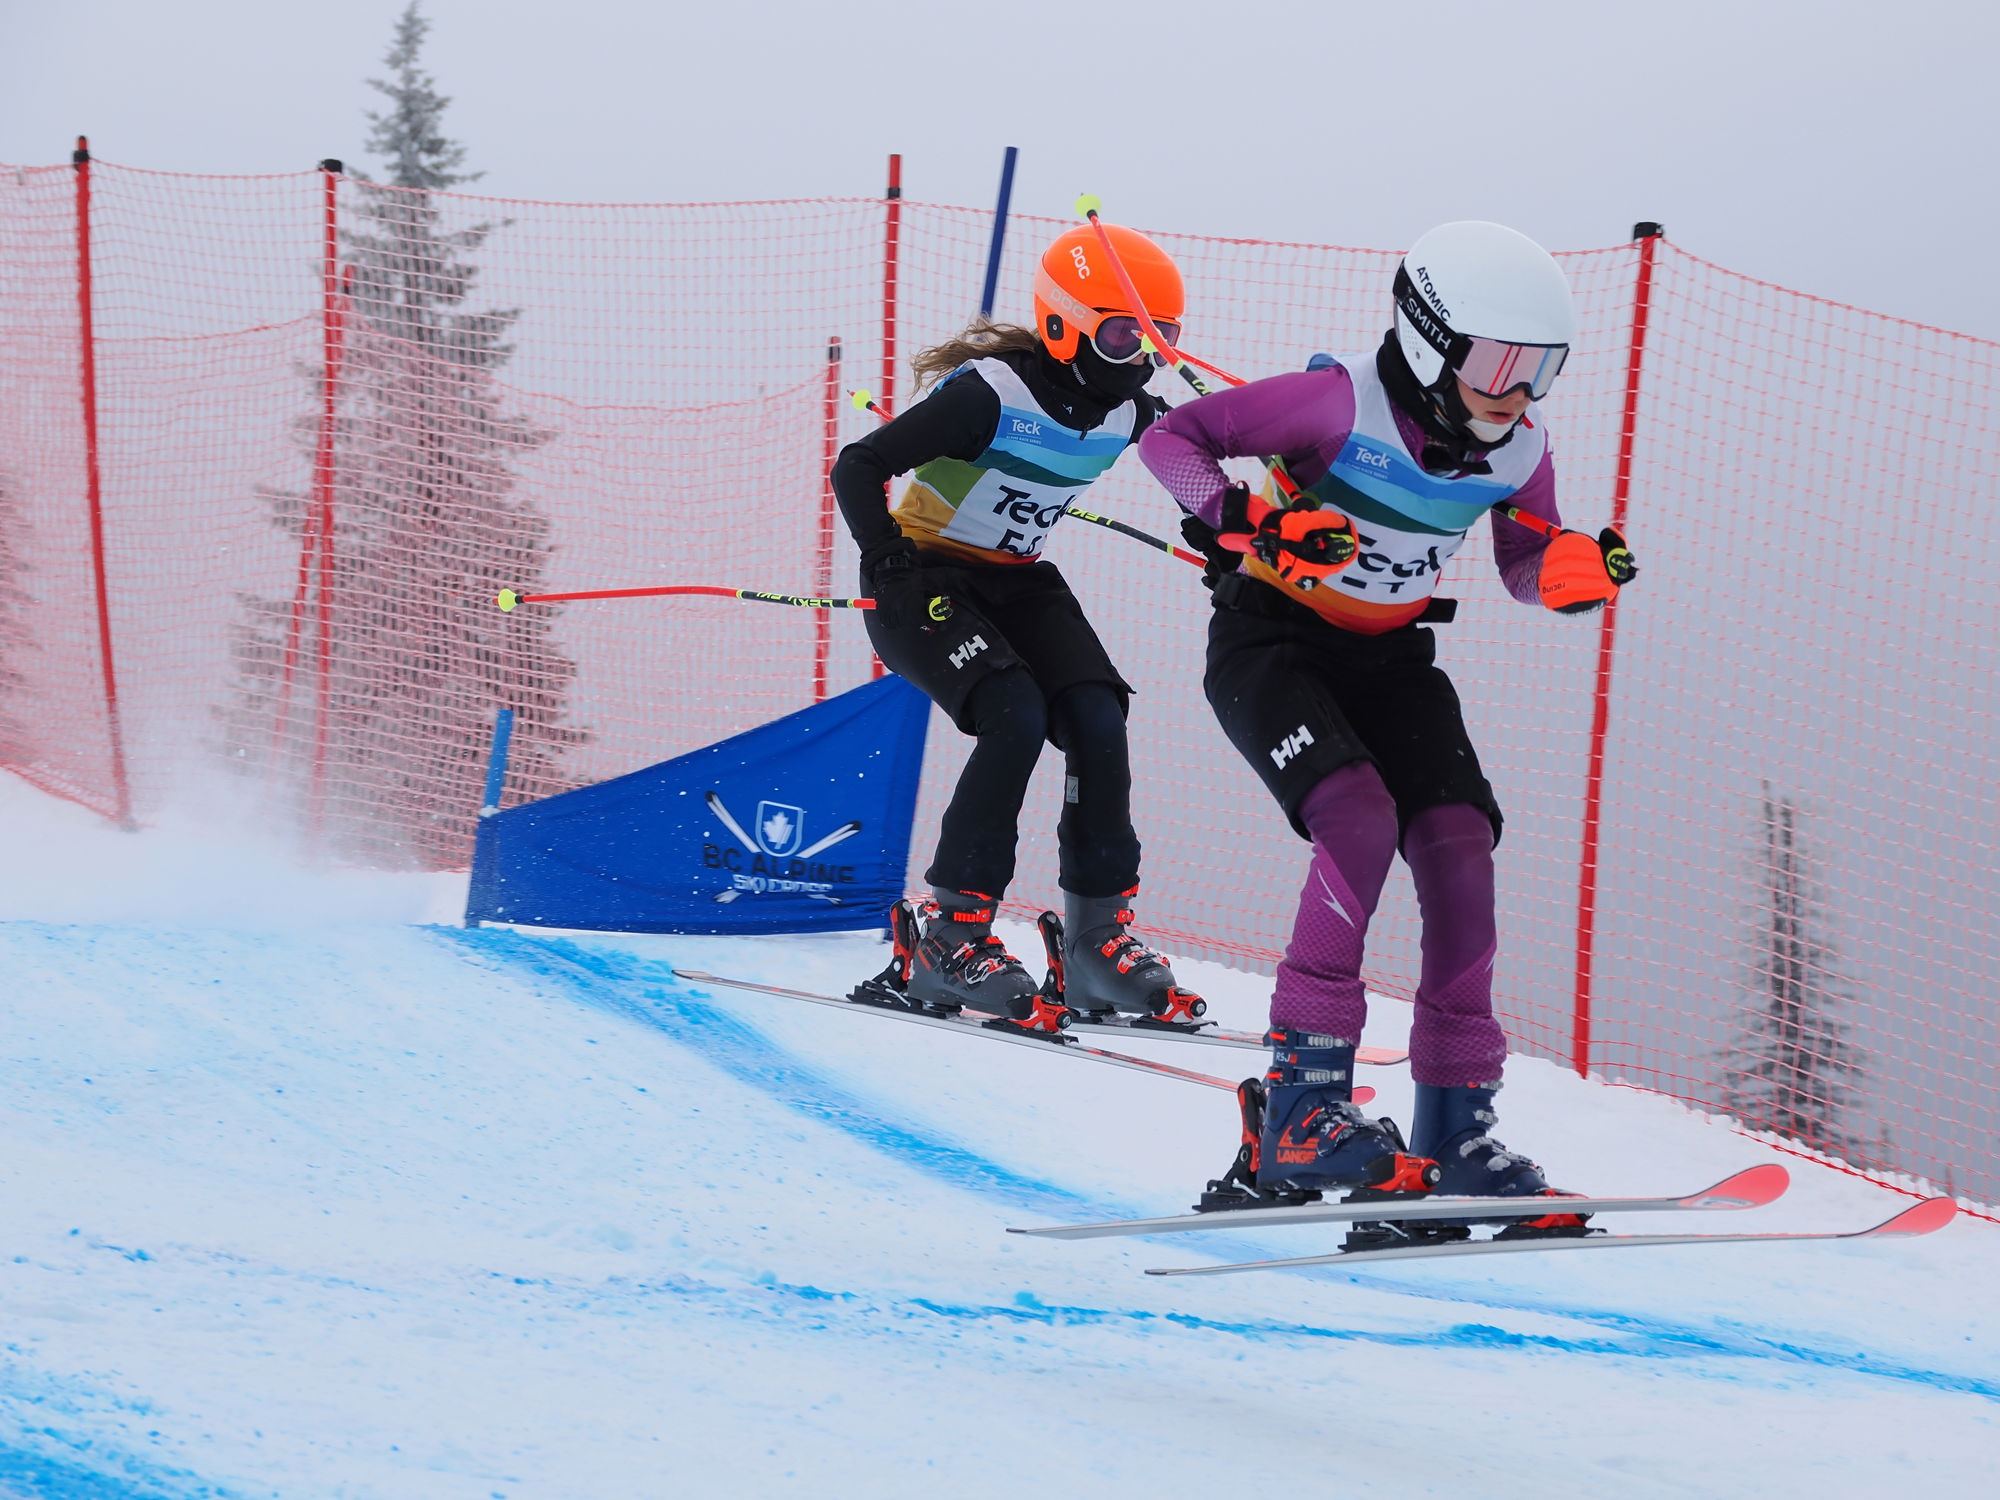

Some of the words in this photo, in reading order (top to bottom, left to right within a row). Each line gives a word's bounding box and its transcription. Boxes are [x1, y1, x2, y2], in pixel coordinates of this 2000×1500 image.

[1416, 266, 1451, 322] ATOMIC
[1406, 297, 1452, 350] SMITH
[1012, 419, 1041, 435] Teck
[1355, 446, 1391, 470] Teck
[948, 634, 989, 670] HH
[1270, 724, 1315, 771] HH
[703, 843, 742, 873] BC
[752, 851, 857, 884] ALPINE
